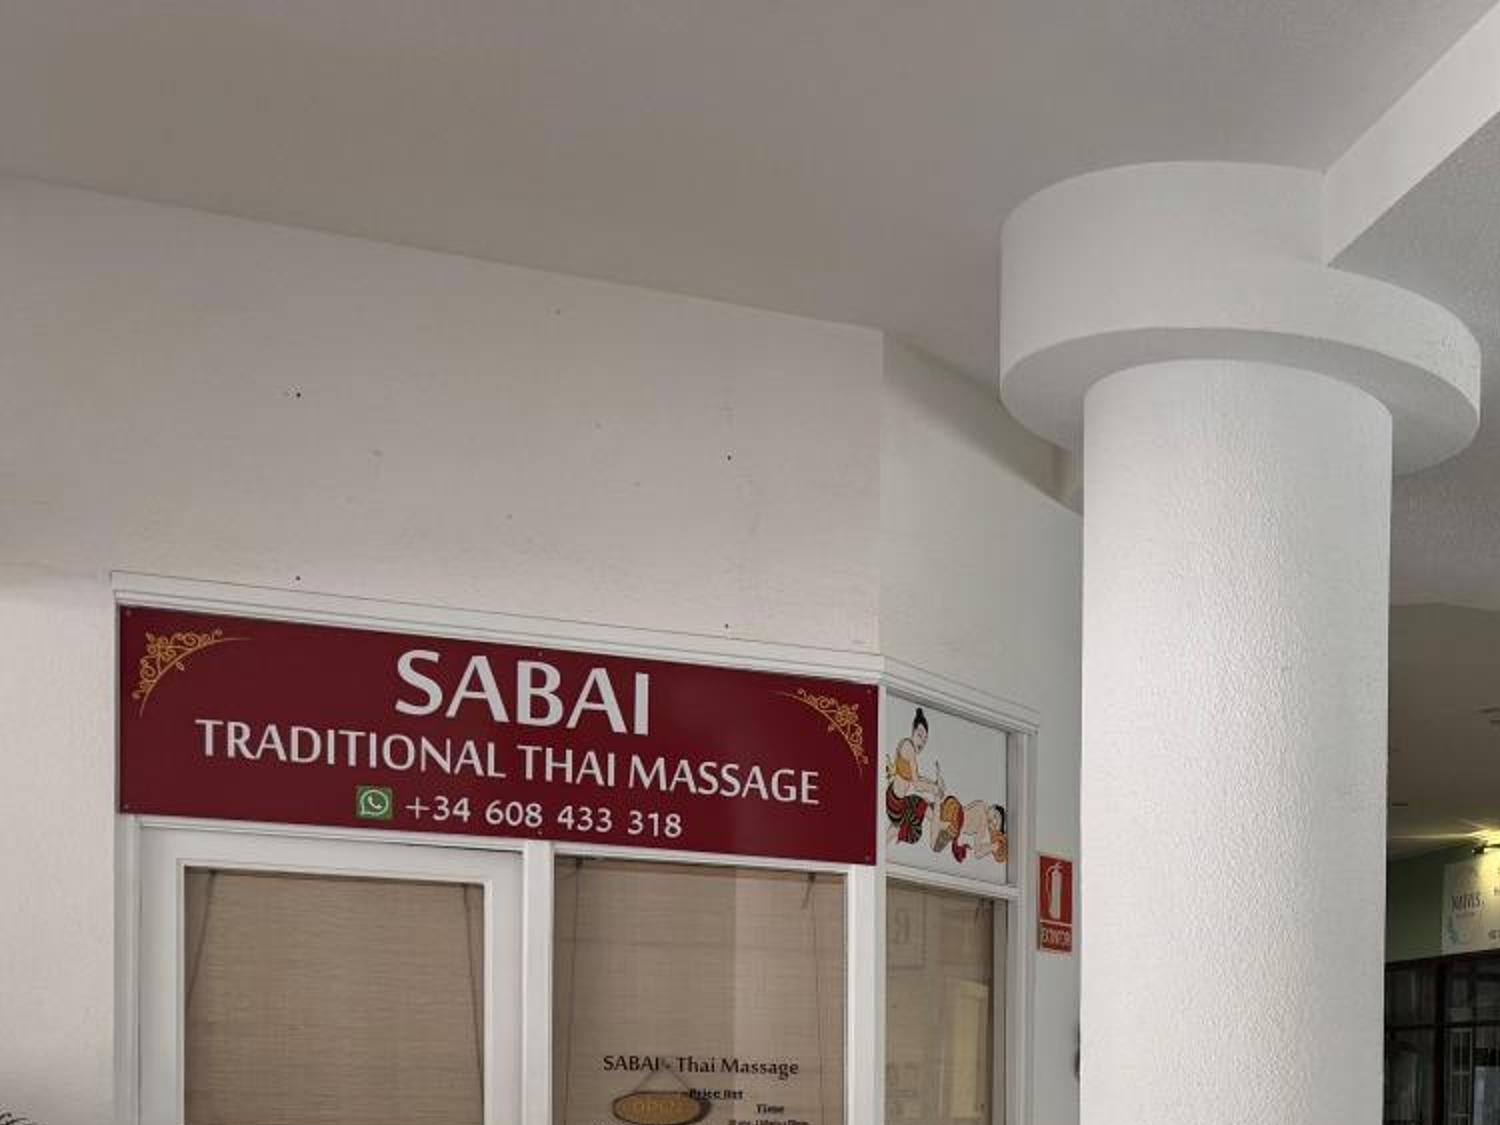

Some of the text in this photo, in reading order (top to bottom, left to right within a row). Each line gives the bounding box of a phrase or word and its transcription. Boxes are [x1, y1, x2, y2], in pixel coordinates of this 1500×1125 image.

[395, 649, 650, 736] SABAI
[194, 718, 820, 805] TRADITIONAL THAI MASSAGE
[405, 795, 683, 839] +34 608 433 318
[602, 1055, 800, 1081] SABAI Thai Massage
